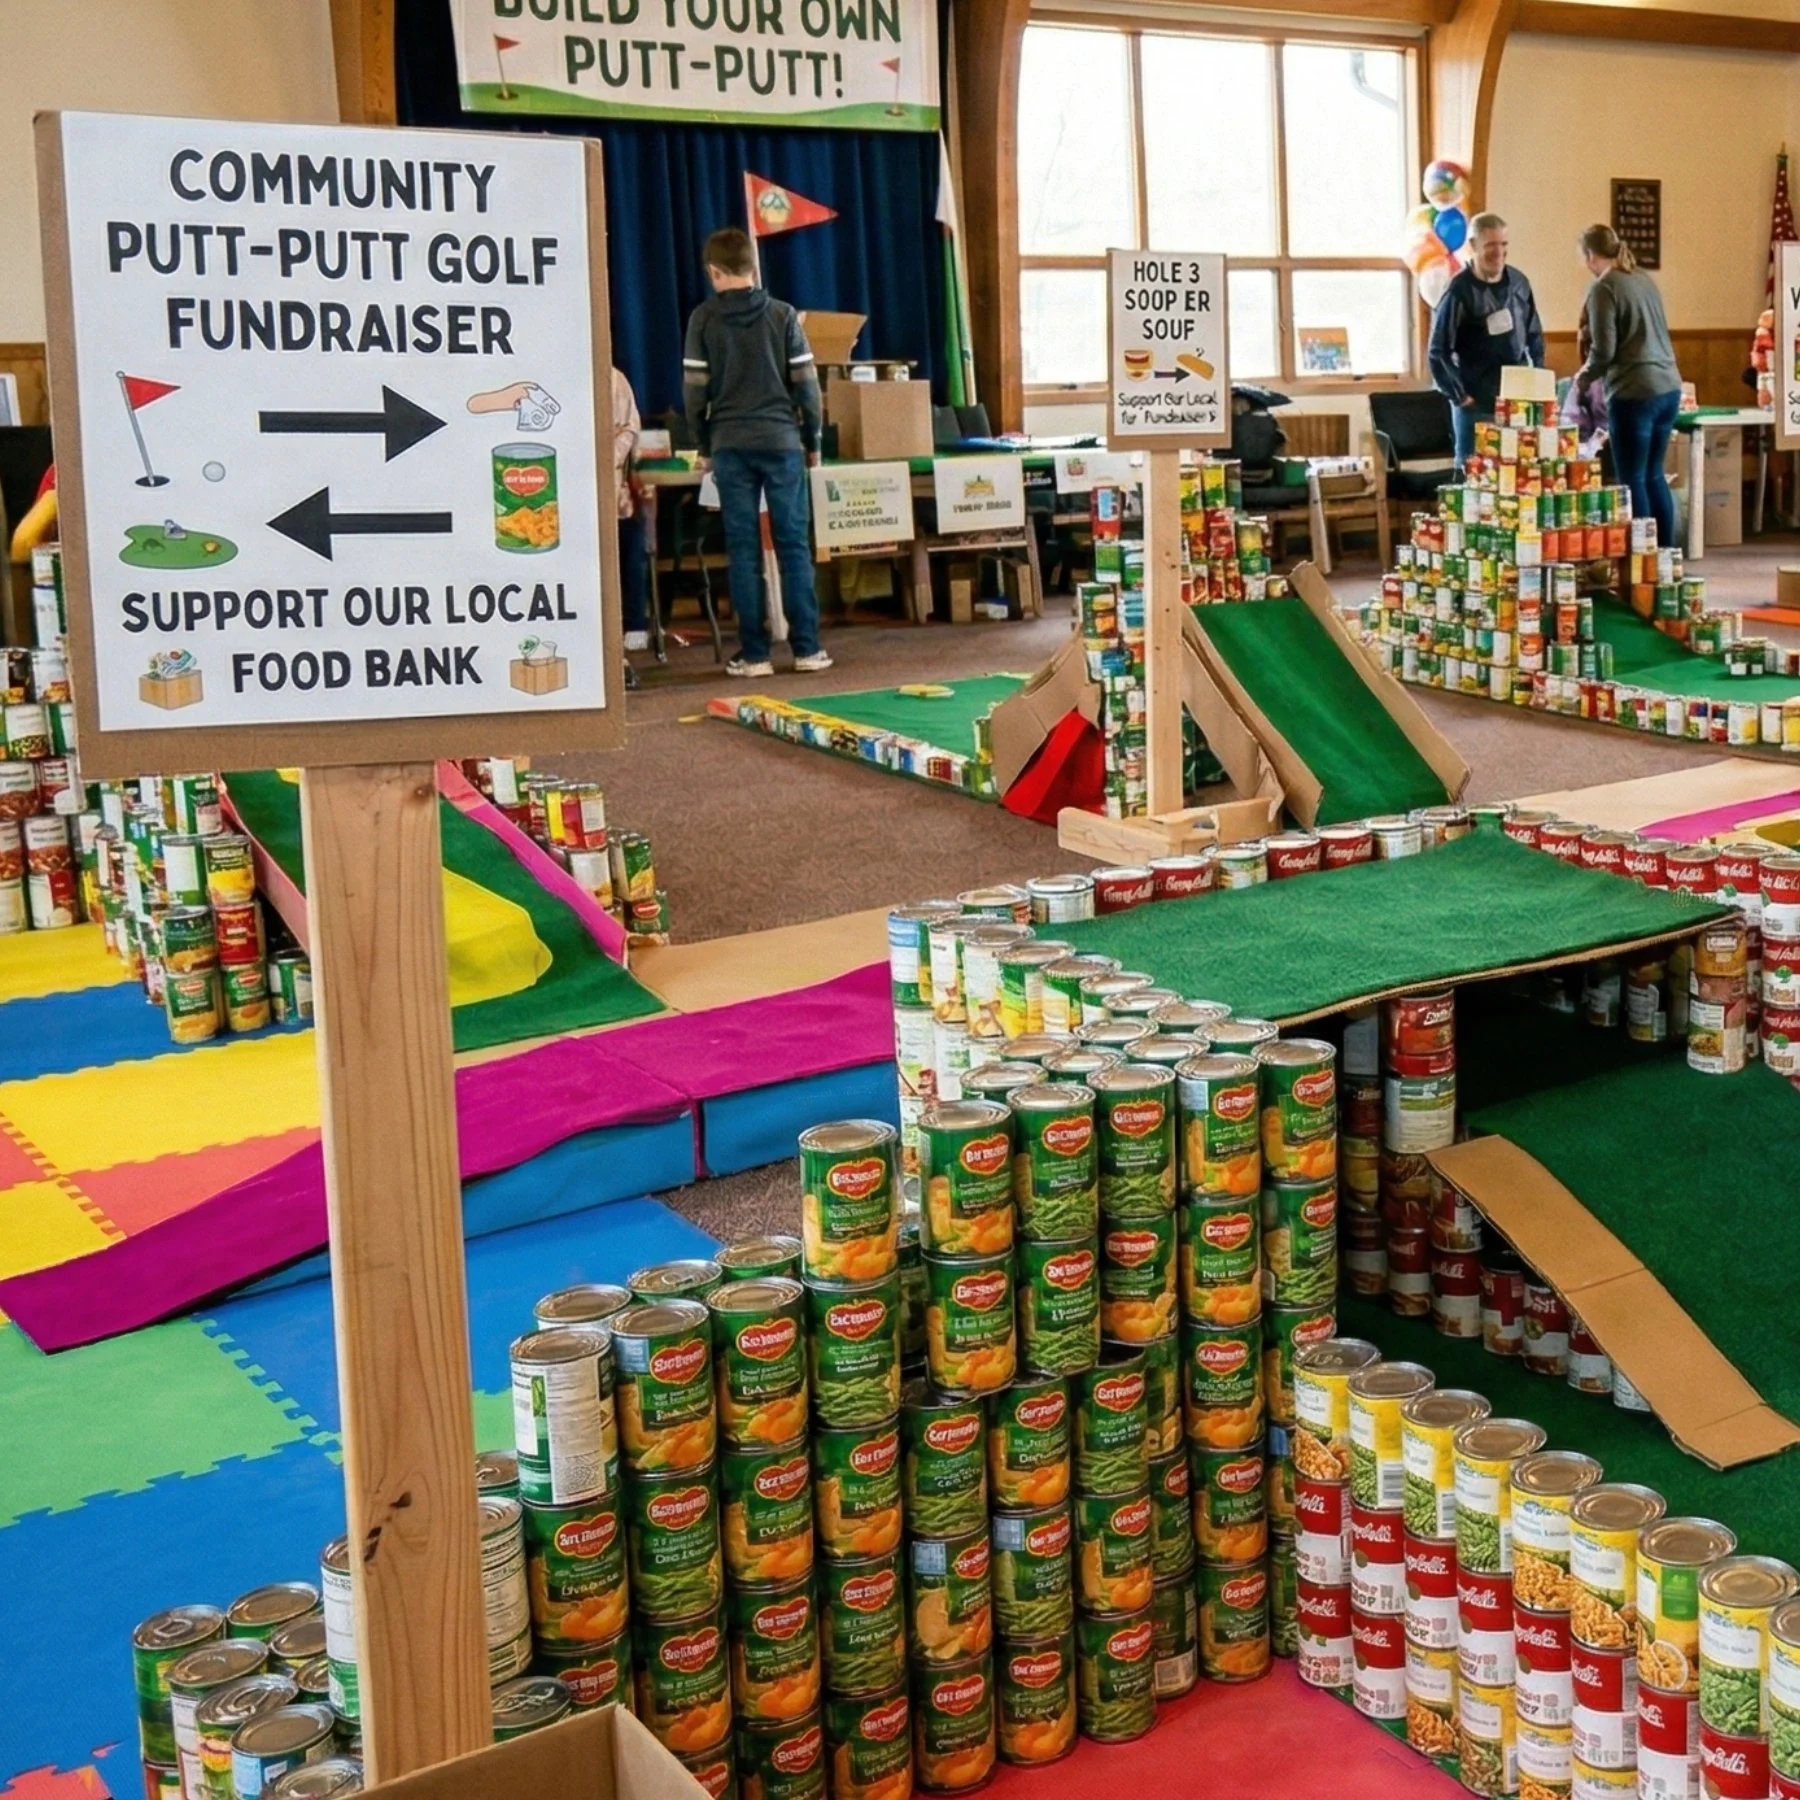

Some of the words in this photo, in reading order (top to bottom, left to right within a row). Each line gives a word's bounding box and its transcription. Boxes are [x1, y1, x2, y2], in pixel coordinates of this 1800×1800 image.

[663, 0, 785, 35] YOUR
[800, 0, 902, 43] OWN
[564, 35, 843, 98] PUTT-PUTT!
[170, 149, 496, 214] COMMUNITY
[106, 221, 410, 283] PUTT-PUTT
[427, 233, 559, 286] GOLF
[1133, 261, 1182, 284] HOLE
[1189, 262, 1200, 284] 3
[1124, 289, 1177, 312] SOOP
[1184, 289, 1211, 312] ER
[166, 297, 515, 356] FUNDRAISER
[1142, 318, 1195, 341] SOUF
[121, 586, 328, 634] SUPPORT
[343, 584, 432, 628] OUR
[445, 580, 578, 626] LOCAL
[232, 649, 353, 694] FOOD
[364, 646, 484, 690] BANK
